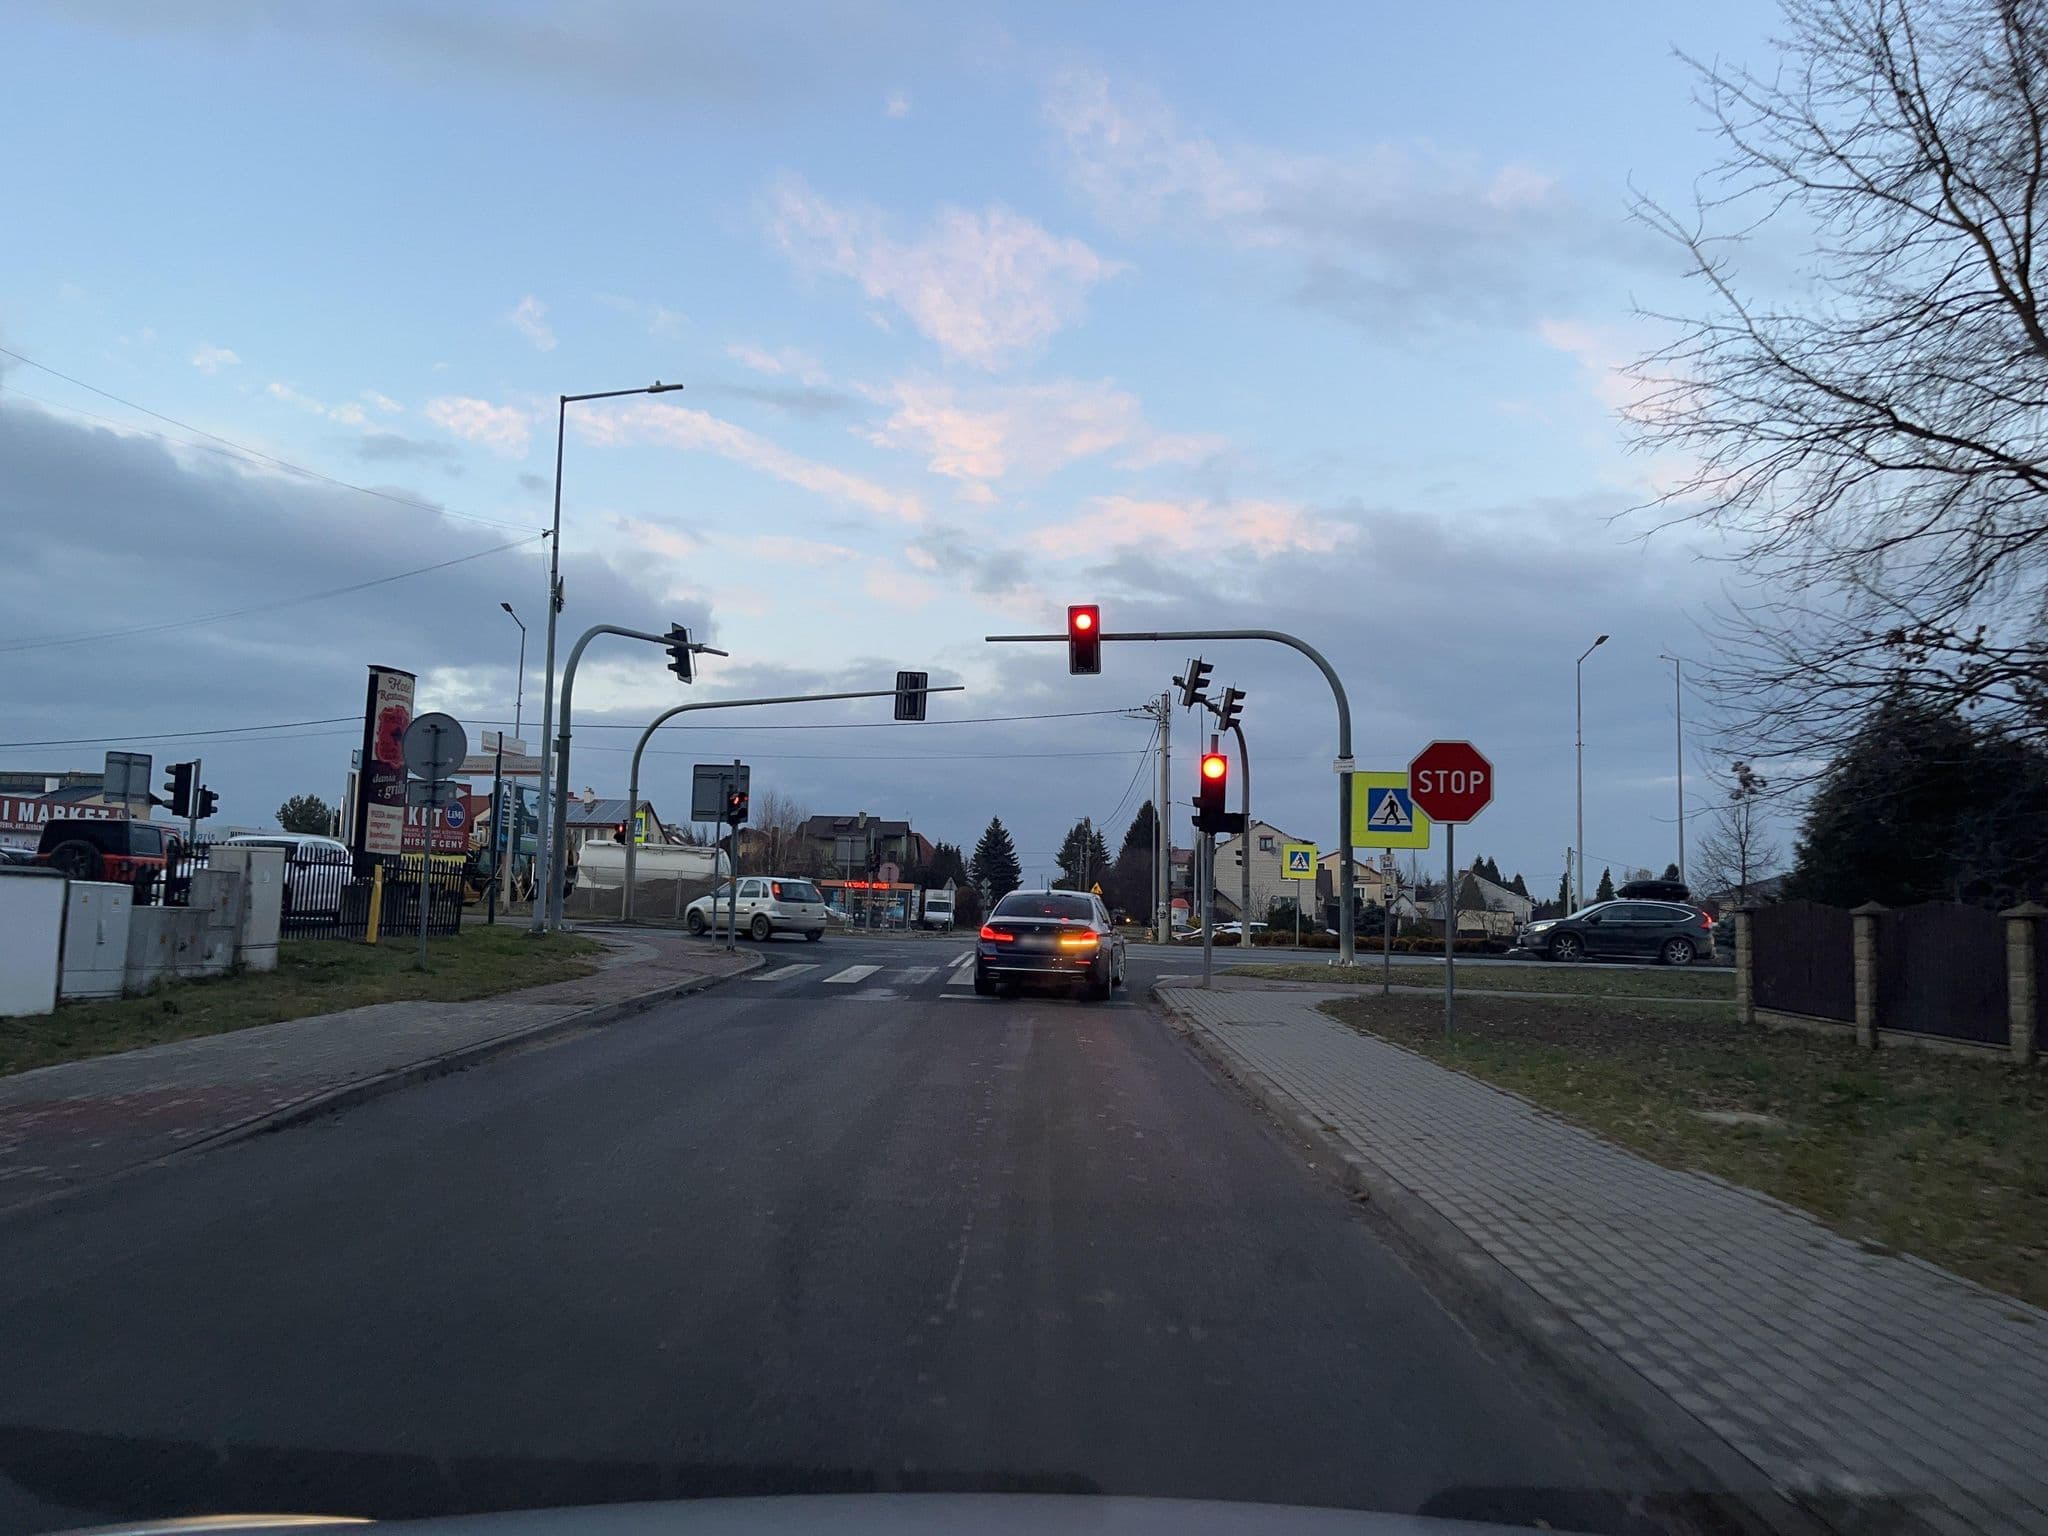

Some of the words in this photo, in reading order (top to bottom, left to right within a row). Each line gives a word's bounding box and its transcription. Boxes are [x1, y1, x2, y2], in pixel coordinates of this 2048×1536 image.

[1418, 770, 1485, 794] STOP
[18, 801, 110, 822] MARKET
[403, 837, 437, 848] NISKE
[439, 840, 463, 849] CENY
